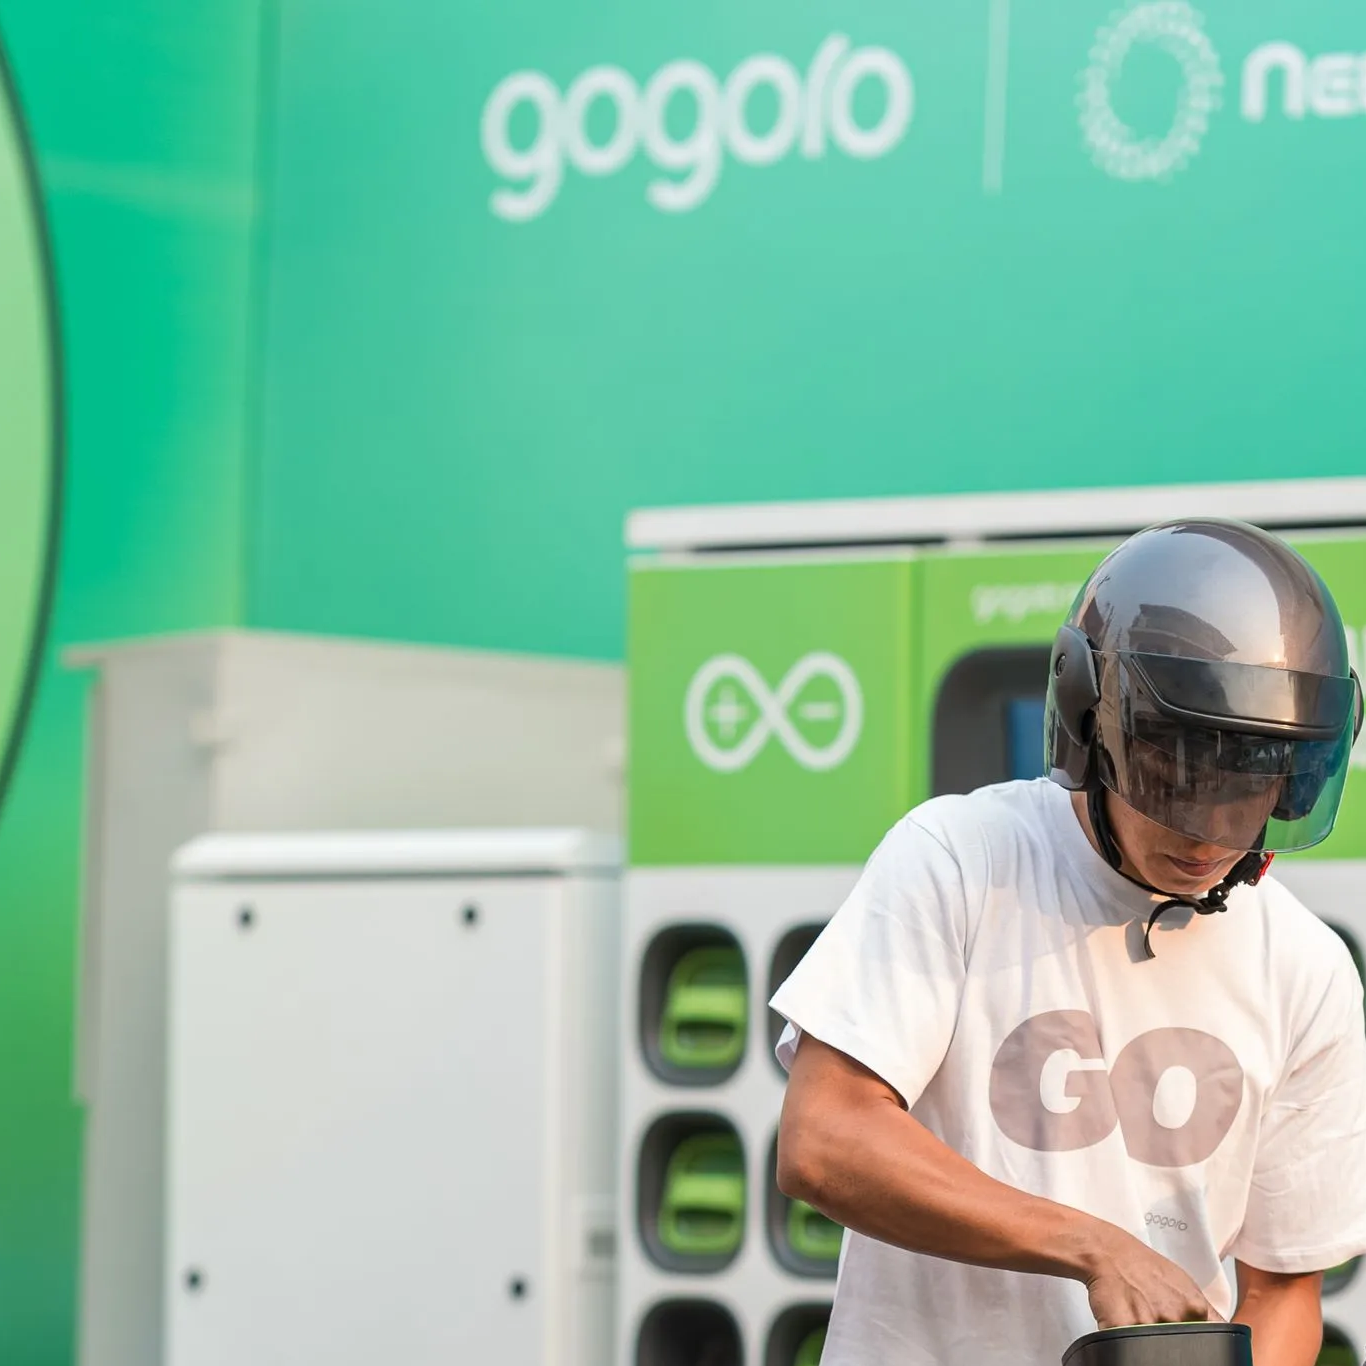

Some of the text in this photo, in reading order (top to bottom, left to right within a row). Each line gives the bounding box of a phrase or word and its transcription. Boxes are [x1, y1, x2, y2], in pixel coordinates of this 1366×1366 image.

[482, 33, 913, 220] gogoro
[989, 1009, 1244, 1168] GO
[1144, 1212, 1188, 1231] gogoro
